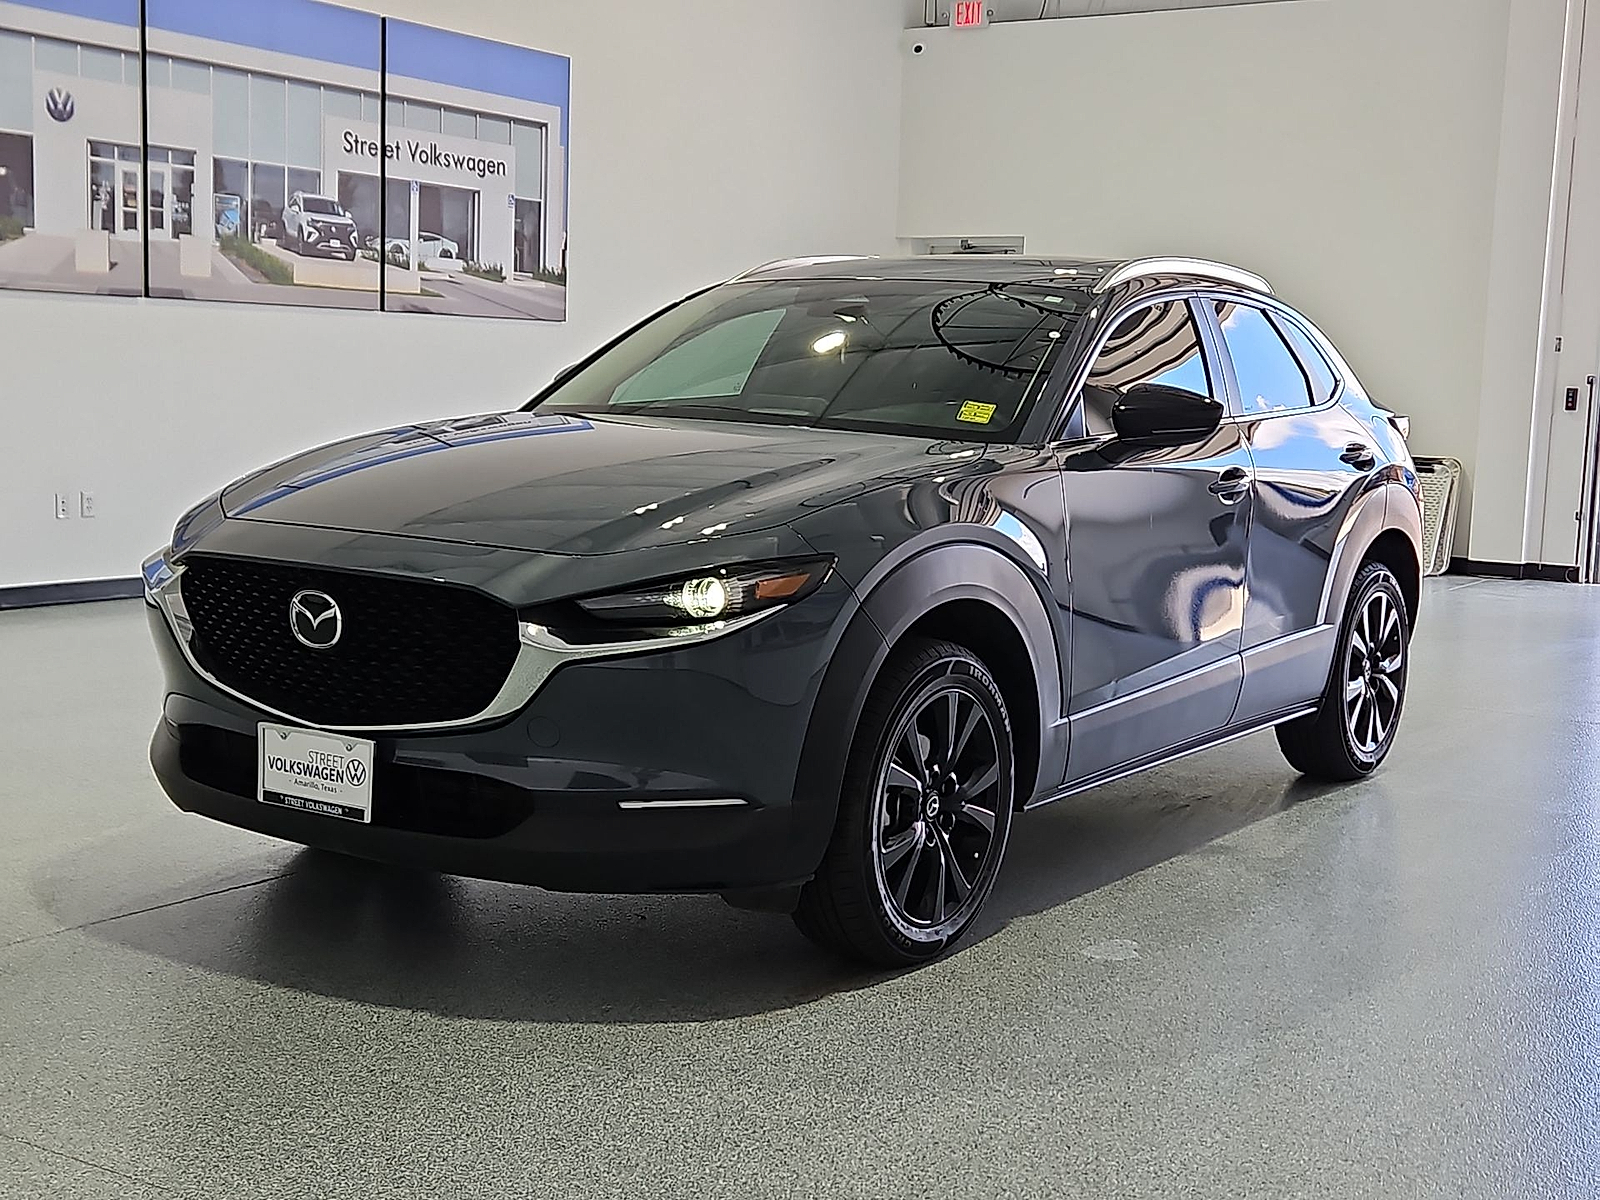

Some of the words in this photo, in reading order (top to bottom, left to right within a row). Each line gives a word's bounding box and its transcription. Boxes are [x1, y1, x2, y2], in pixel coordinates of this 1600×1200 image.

[956, 1, 982, 25] EXIT
[343, 131, 400, 161] Street
[407, 140, 507, 178] Volkswagen
[267, 755, 345, 784] VOLKSWAGEN
[308, 750, 345, 769] STREET
[321, 783, 338, 794] Texas
[284, 796, 304, 808] STREET
[304, 800, 343, 815] VOLKSWAGEN
